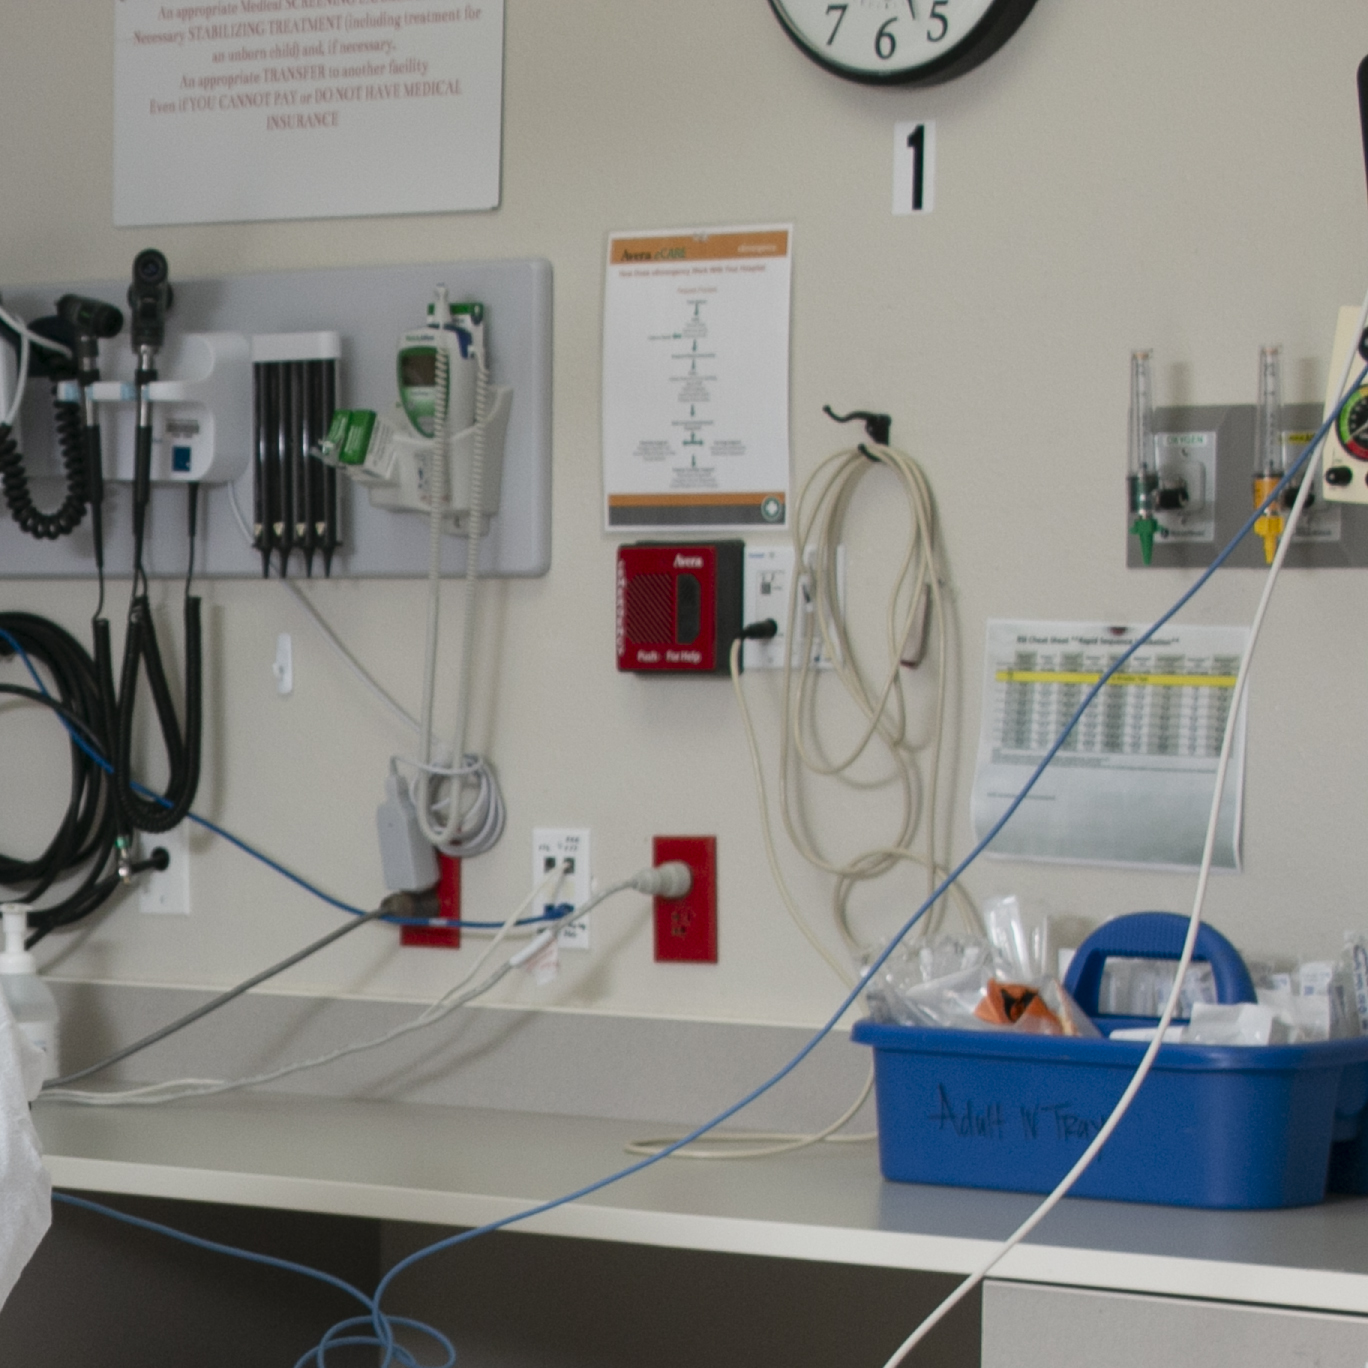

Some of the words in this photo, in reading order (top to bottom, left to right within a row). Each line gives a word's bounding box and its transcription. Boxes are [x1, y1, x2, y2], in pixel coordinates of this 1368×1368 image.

[133, 30, 184, 46] Necessary
[188, 22, 265, 41] STABILIZING
[269, 15, 343, 35] TREATMENT
[404, 8, 461, 25] treatment
[464, 3, 482, 21] for
[158, 6, 173, 20] An
[176, 4, 239, 22] appropriate
[825, 3, 849, 46] 7
[212, 52, 225, 63] an
[228, 46, 267, 62] unborn
[328, 39, 339, 55] if
[874, 16, 899, 60] 6
[180, 74, 196, 88] An
[197, 71, 260, 90] appropriate
[263, 65, 325, 83] TRANSFER
[328, 66, 339, 79] to
[341, 61, 386, 77] another
[389, 57, 429, 77] facility
[149, 98, 176, 115] Even
[186, 95, 215, 111] YOU
[218, 91, 271, 110] CANNOT
[274, 90, 298, 107] PAY
[315, 87, 334, 103] DO
[335, 85, 363, 102] NOT
[365, 82, 401, 101] HAVE
[404, 78, 462, 98] MEDICAL
[266, 110, 339, 130] INSURANCE
[906, 123, 925, 211] 1
[672, 553, 704, 569] Avera
